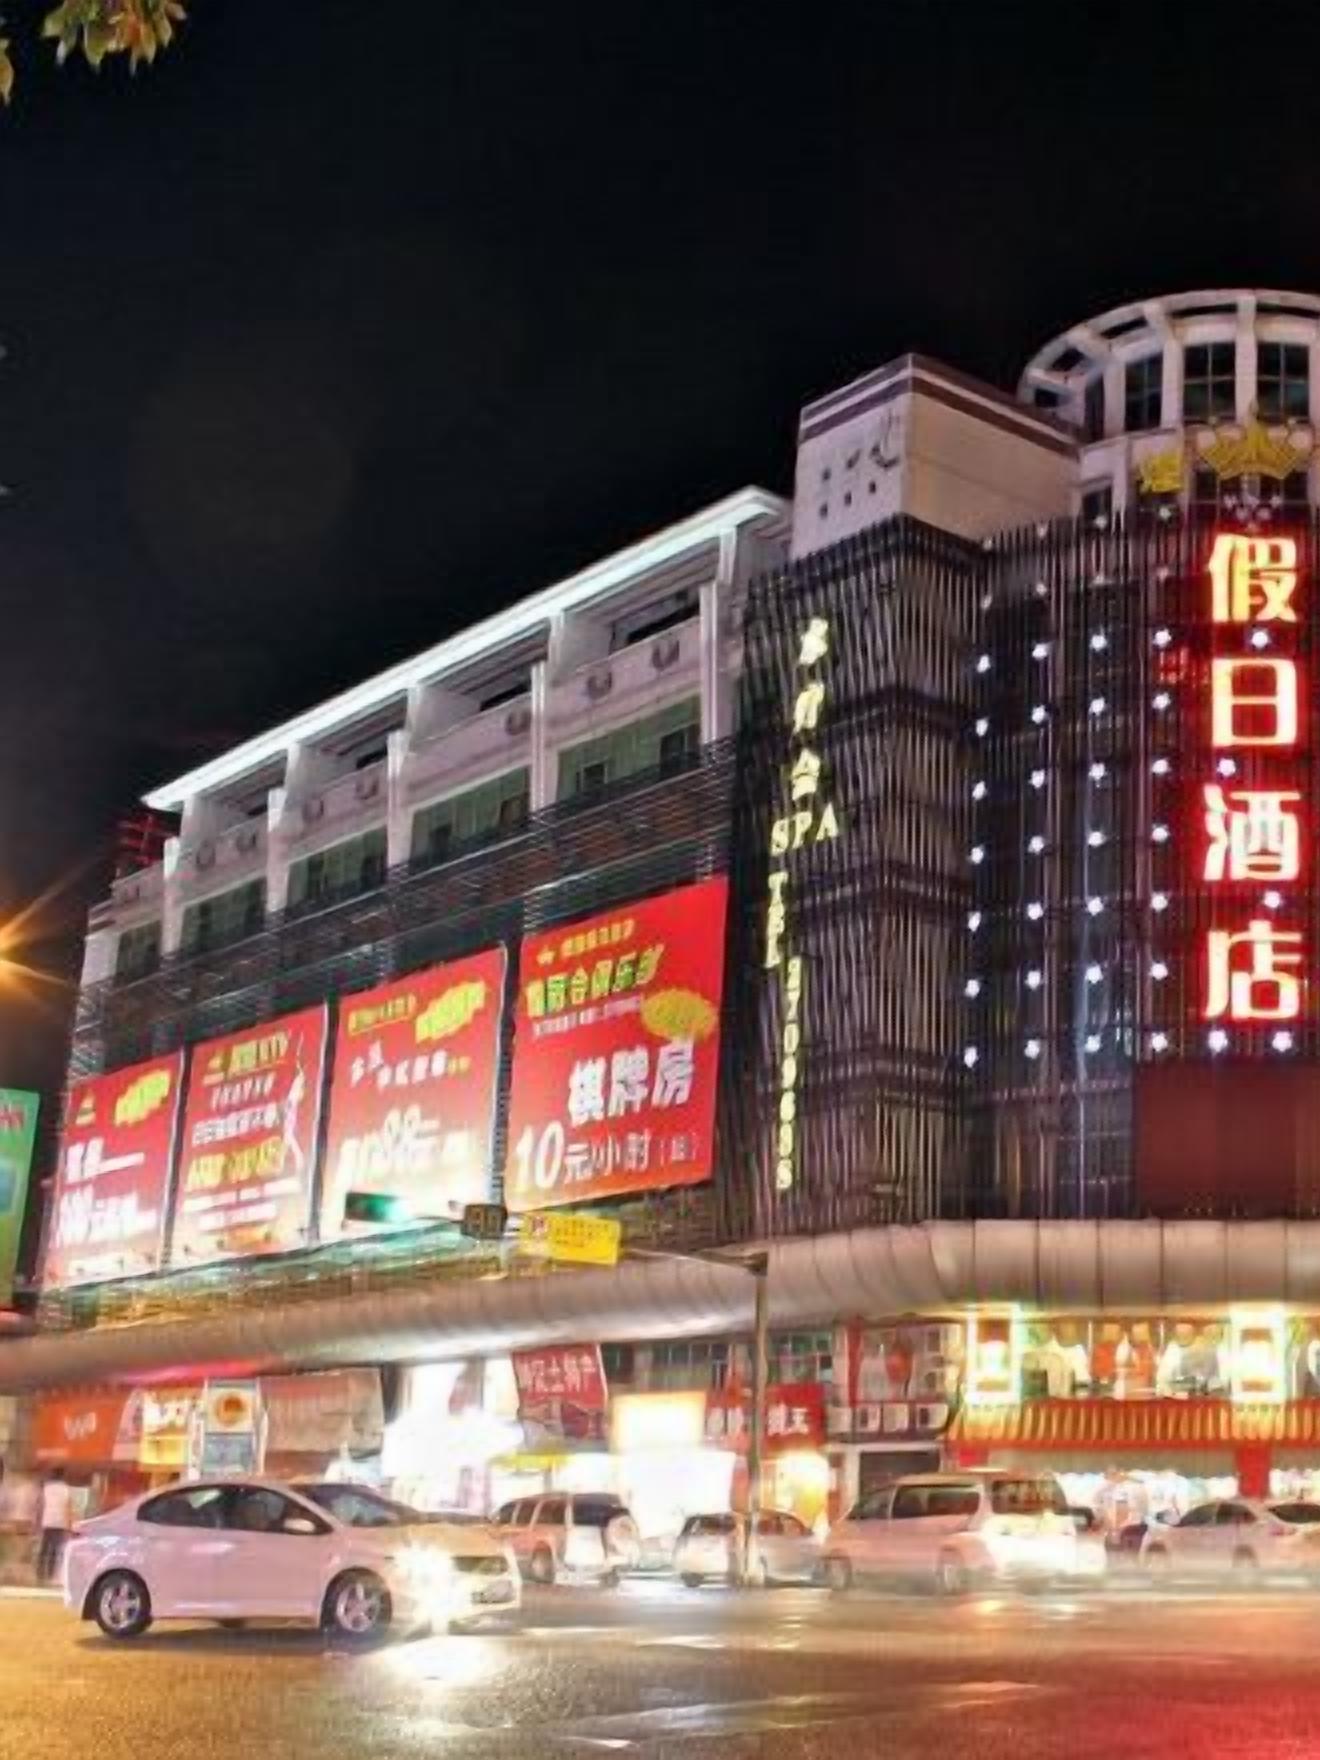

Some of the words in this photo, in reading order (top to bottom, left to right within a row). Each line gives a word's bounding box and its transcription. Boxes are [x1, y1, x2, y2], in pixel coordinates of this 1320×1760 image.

[1204, 534, 1302, 1020] 假日酒店
[771, 803, 839, 856] SPA
[568, 1038, 693, 1127] 棋牌房
